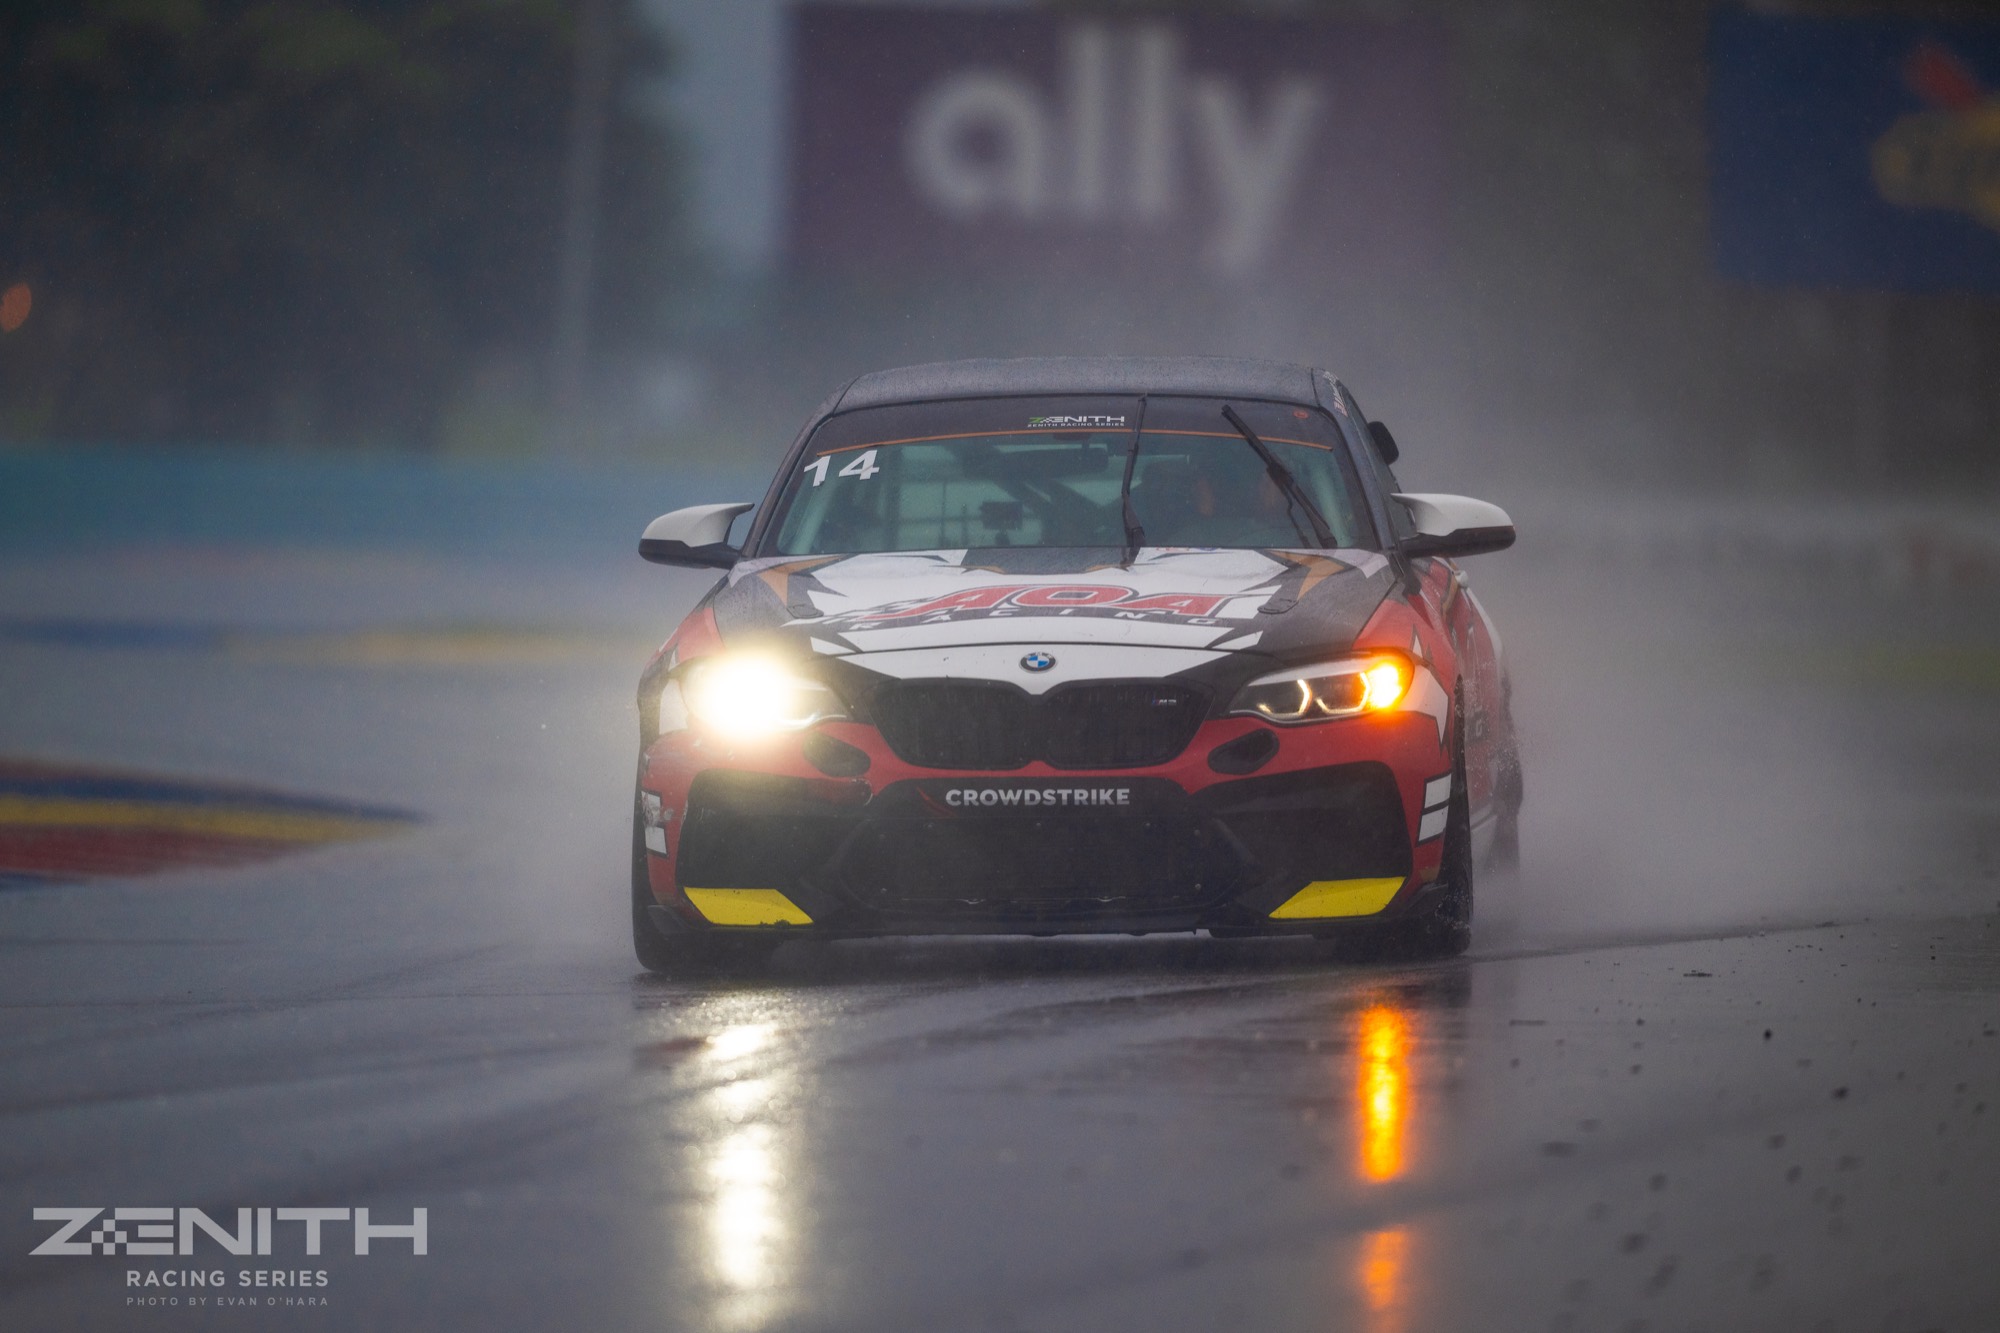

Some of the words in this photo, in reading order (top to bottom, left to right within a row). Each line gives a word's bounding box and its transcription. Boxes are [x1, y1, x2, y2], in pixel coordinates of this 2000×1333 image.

[909, 22, 1322, 270] ally
[803, 449, 880, 487] 14
[849, 608, 1219, 630] RACING
[945, 788, 1130, 806] CROWDSTRIKE
